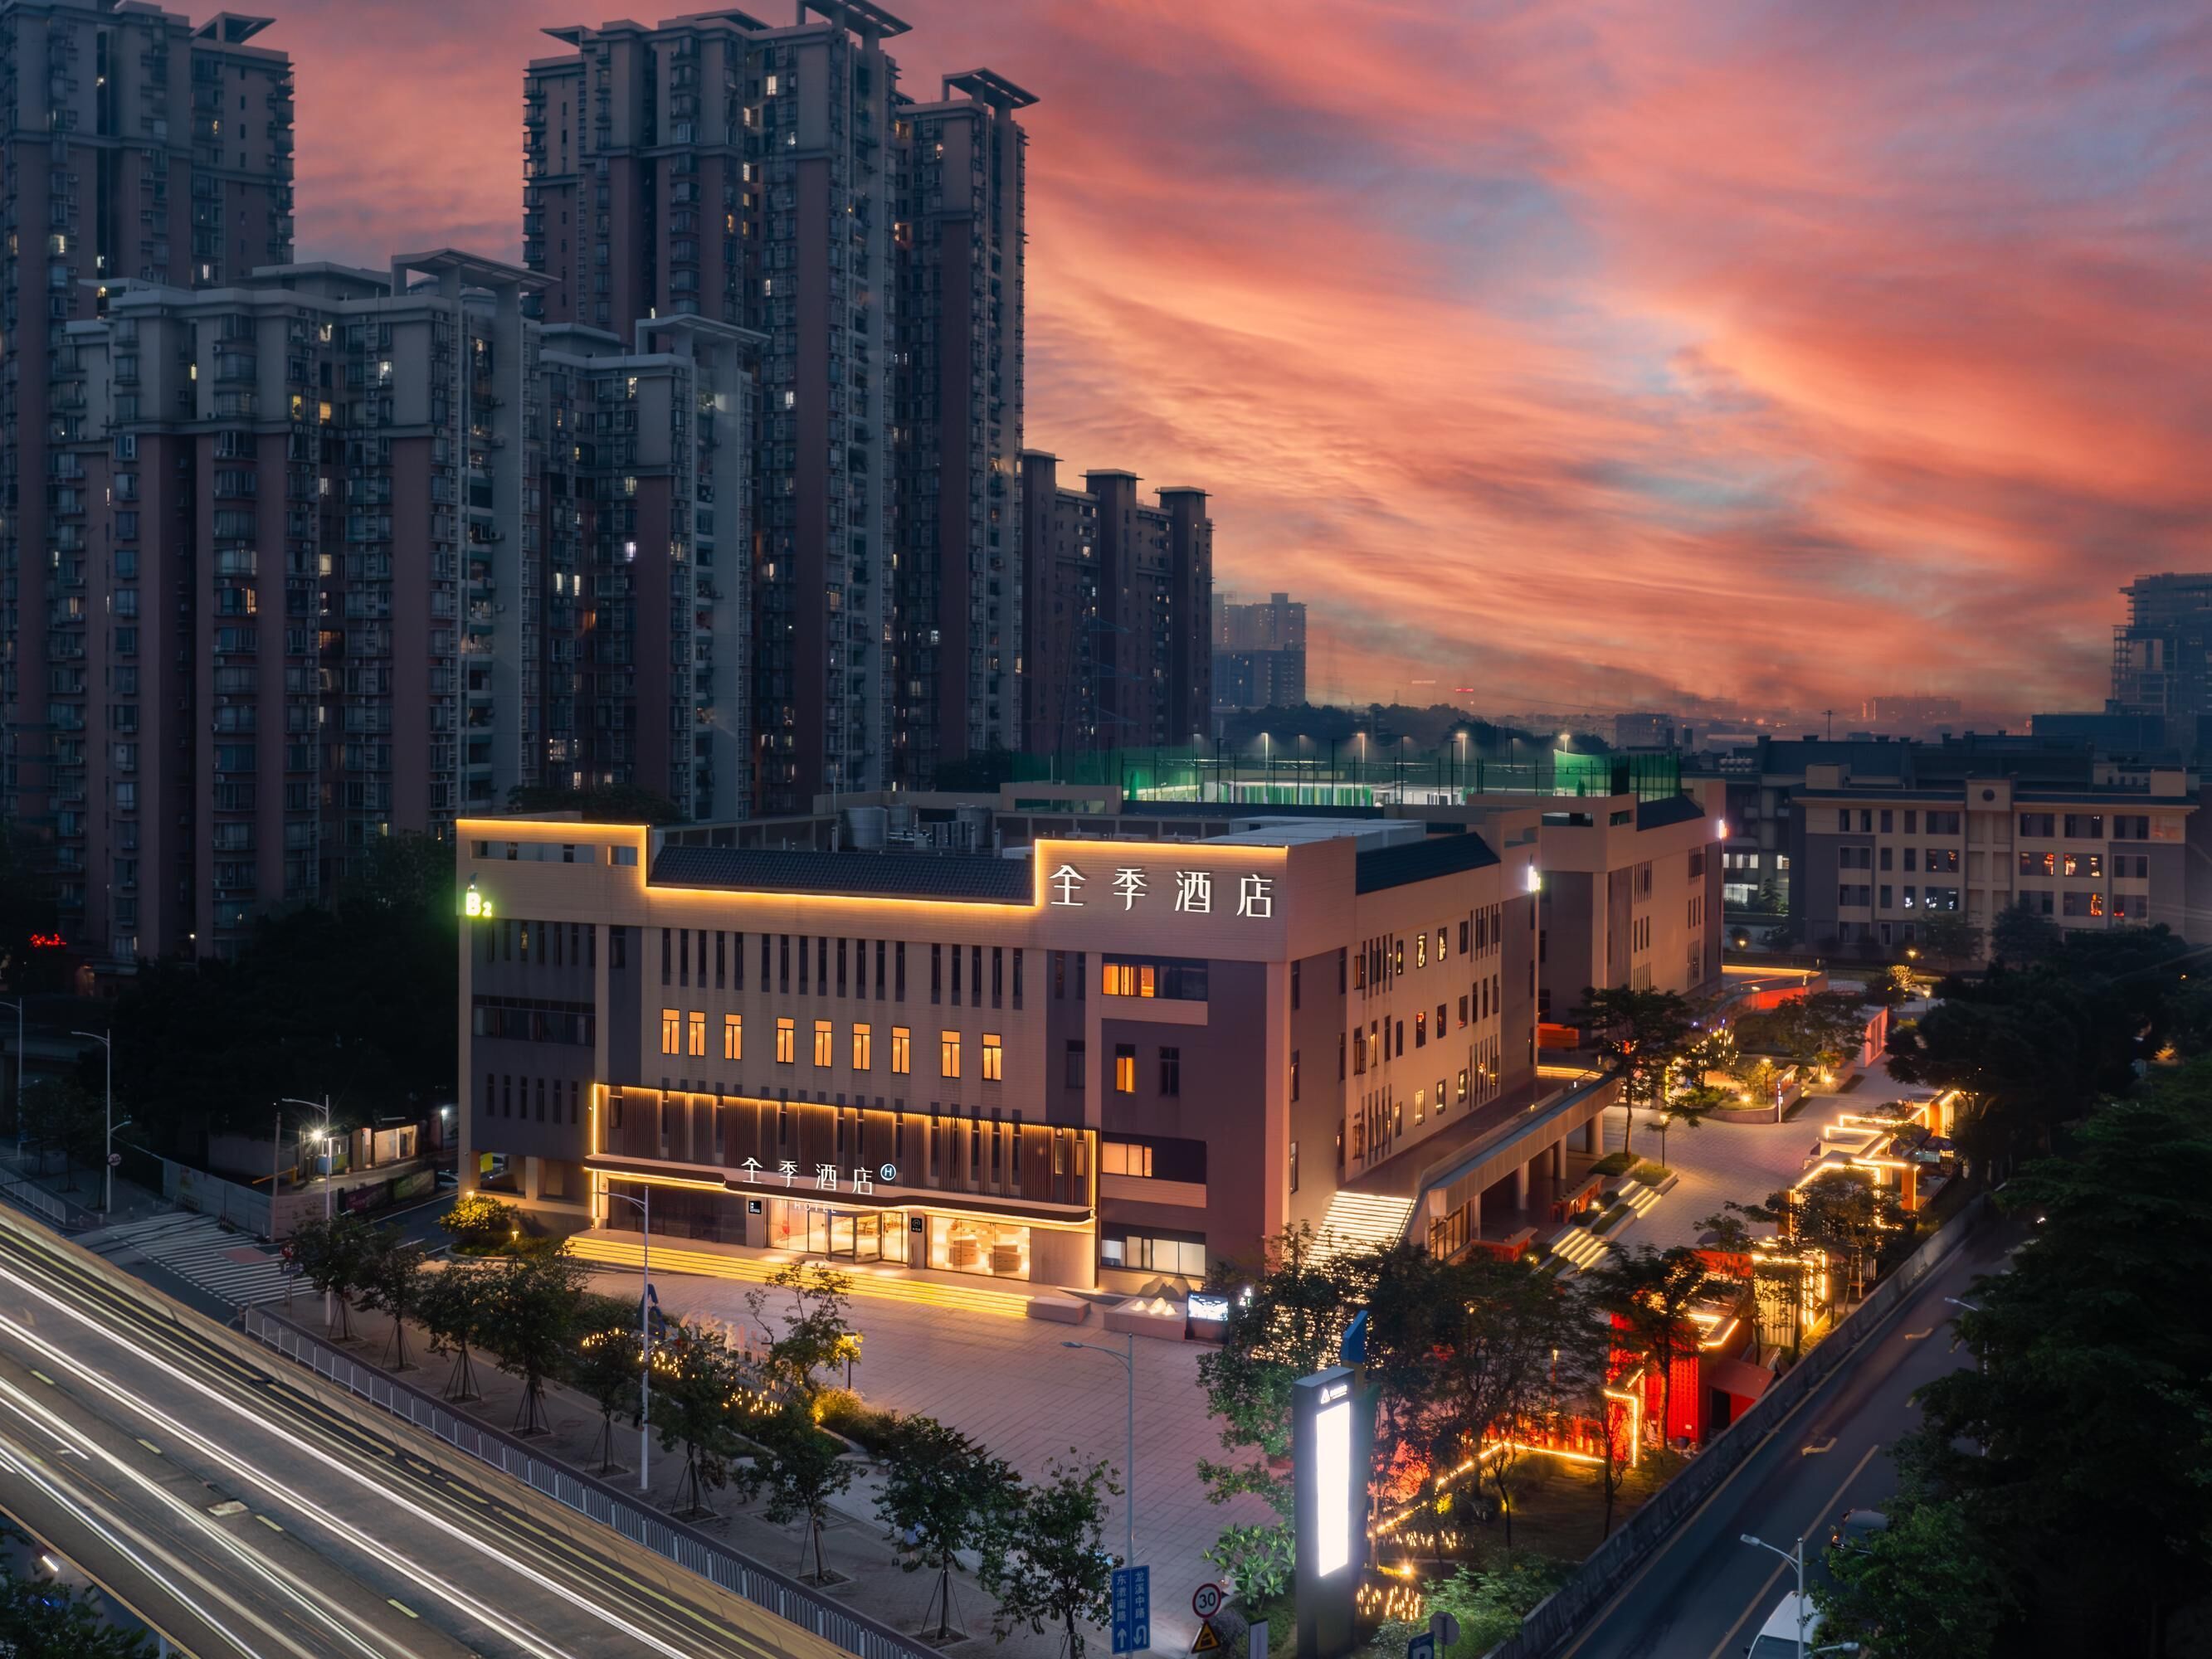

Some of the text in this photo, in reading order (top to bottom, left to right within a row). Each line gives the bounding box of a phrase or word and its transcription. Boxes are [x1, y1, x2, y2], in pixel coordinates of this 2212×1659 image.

[1048, 864, 1274, 918] 全季酒店
[740, 1156, 874, 1195] 全季酒店
[794, 1200, 837, 1214] HOTEL
[1198, 1592, 1216, 1609] 30
